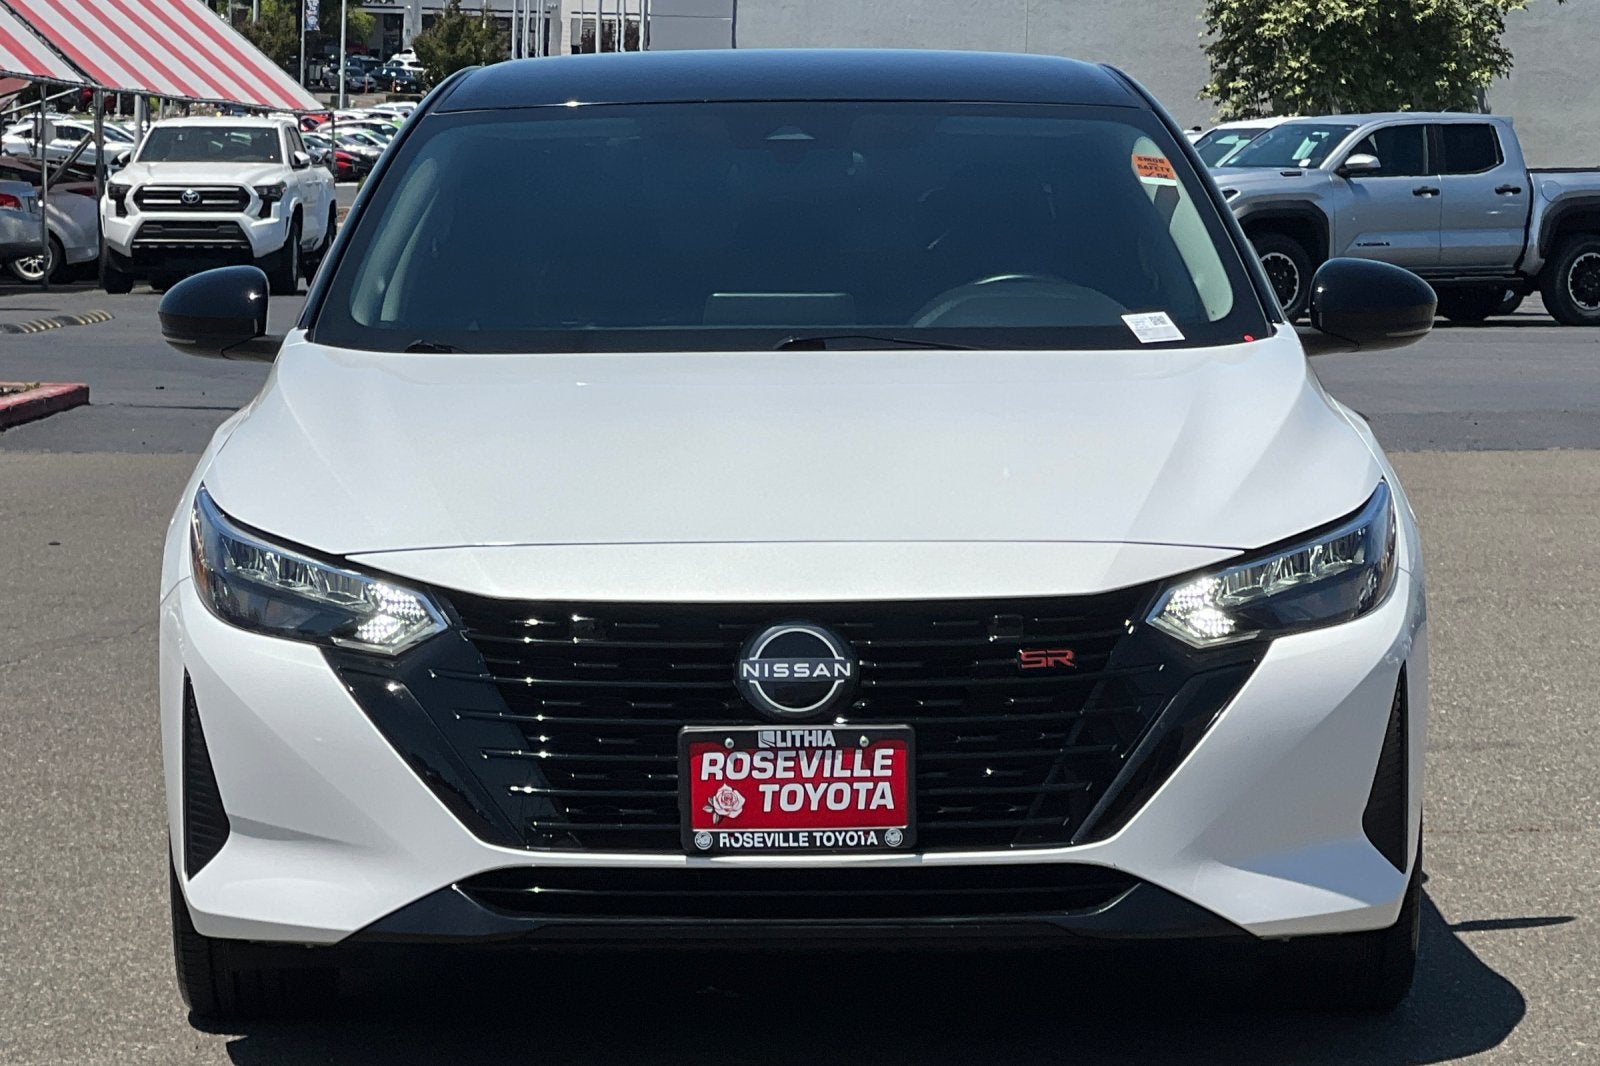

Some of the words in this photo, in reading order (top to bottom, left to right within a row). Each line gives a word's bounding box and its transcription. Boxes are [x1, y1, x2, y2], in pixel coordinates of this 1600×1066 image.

[1019, 649, 1075, 669] SR
[742, 662, 851, 678] NISSAN
[775, 730, 836, 748] LITHIA
[700, 748, 895, 781] ROSEVILLE
[758, 781, 895, 812] TOYOTA
[719, 832, 809, 848] ROSEVILLE
[812, 831, 878, 847] TOYOTA
